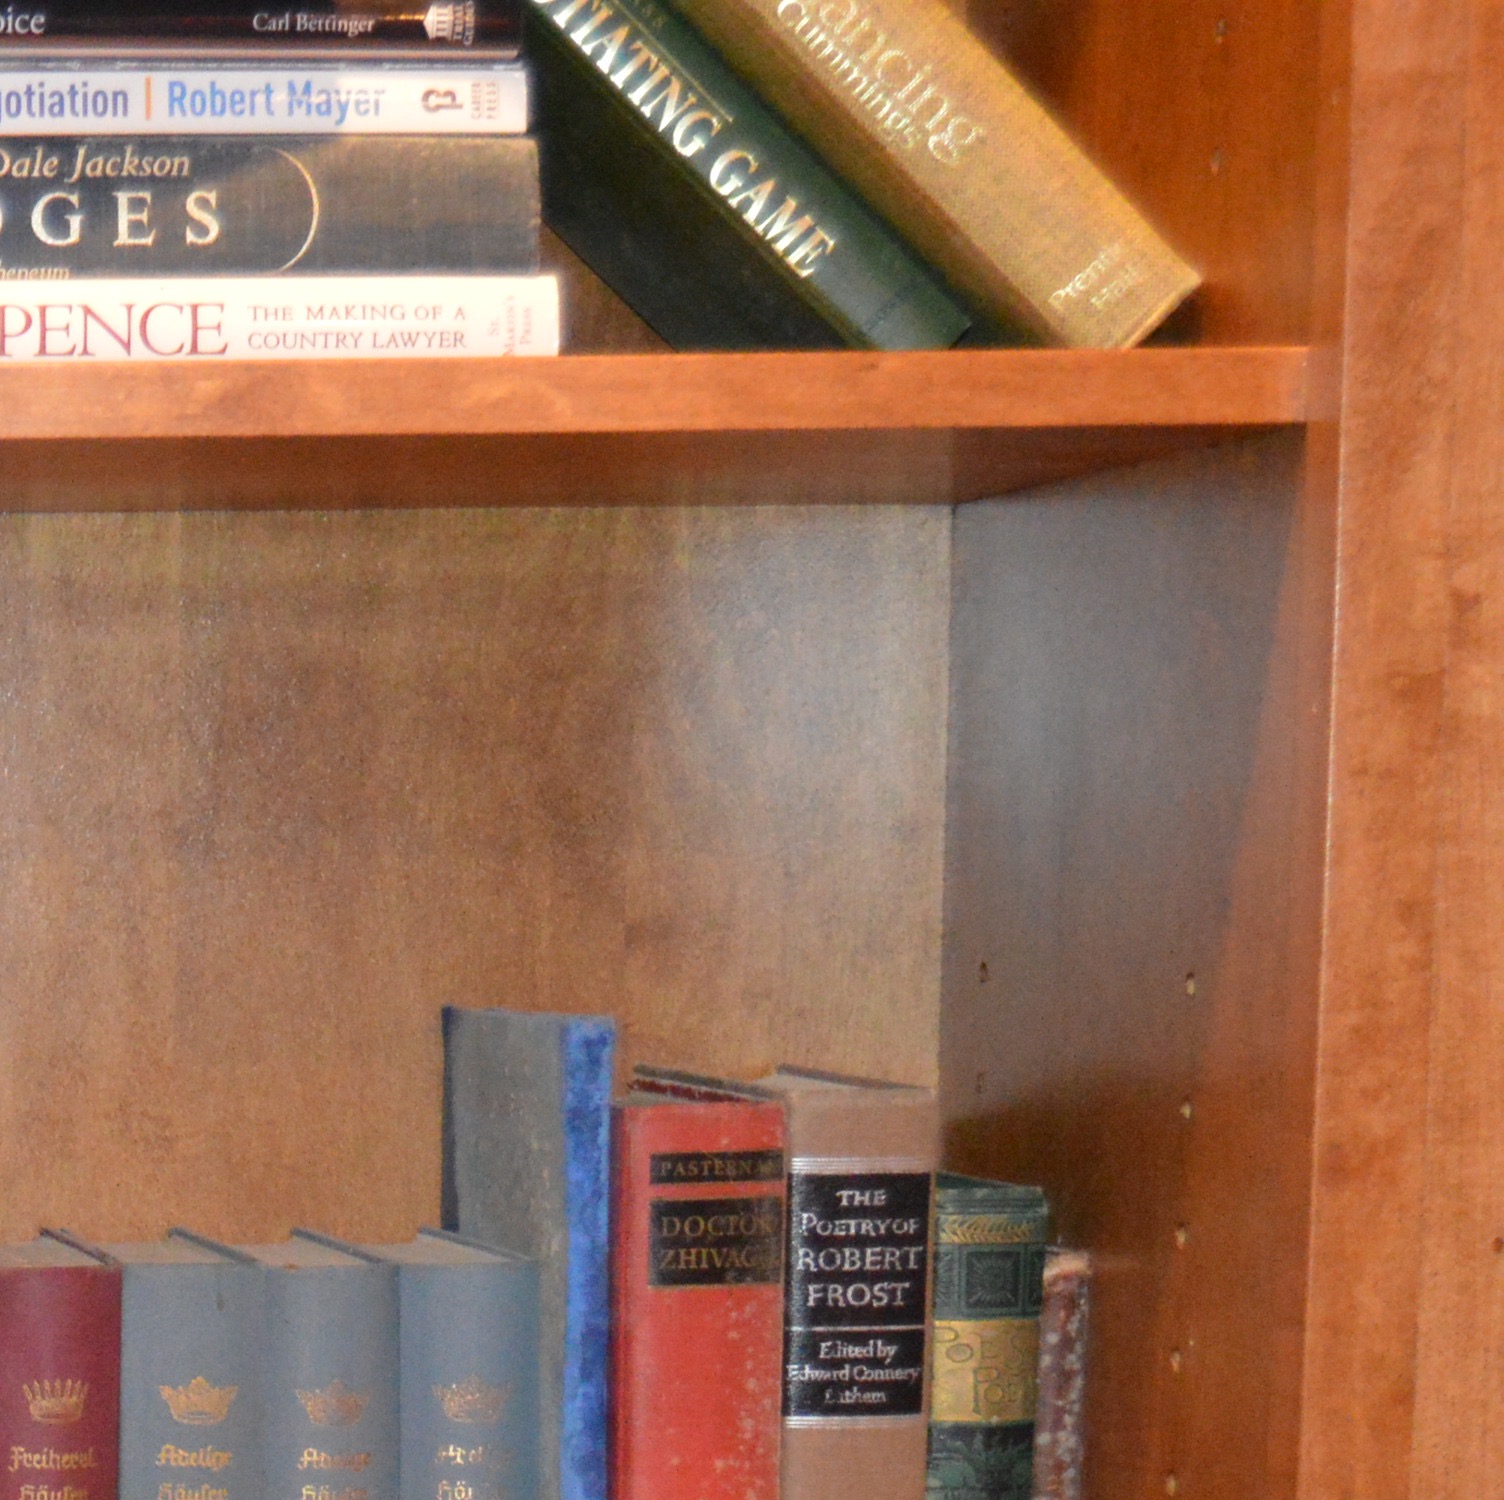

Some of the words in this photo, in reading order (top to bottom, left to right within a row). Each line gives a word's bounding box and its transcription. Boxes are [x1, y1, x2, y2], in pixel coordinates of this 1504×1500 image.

[253, 12, 289, 32] Carl
[296, 12, 375, 36] Bettinger
[777, 0, 922, 150] Cummings
[167, 80, 275, 118] Robert
[287, 80, 386, 126] Mayer
[532, 0, 722, 158] TIATING
[709, 149, 836, 278] GAME
[65, 144, 190, 186] Jackson
[248, 305, 293, 321] THE
[306, 305, 405, 321] MAKING
[413, 305, 443, 320] OF
[453, 305, 466, 320] A
[248, 331, 364, 350] COUNTRY
[372, 331, 467, 350] LAWYER
[835, 1188, 888, 1208] THE
[661, 1213, 775, 1239] DOCTOR
[801, 1212, 892, 1237] POETRY
[893, 1217, 921, 1235] OF
[796, 1246, 924, 1273] ROBERT
[807, 1281, 911, 1308] FROST
[818, 1340, 875, 1360] Edited
[876, 1340, 899, 1366] by
[786, 1364, 851, 1383] Edward
[853, 1364, 922, 1386] Connery
